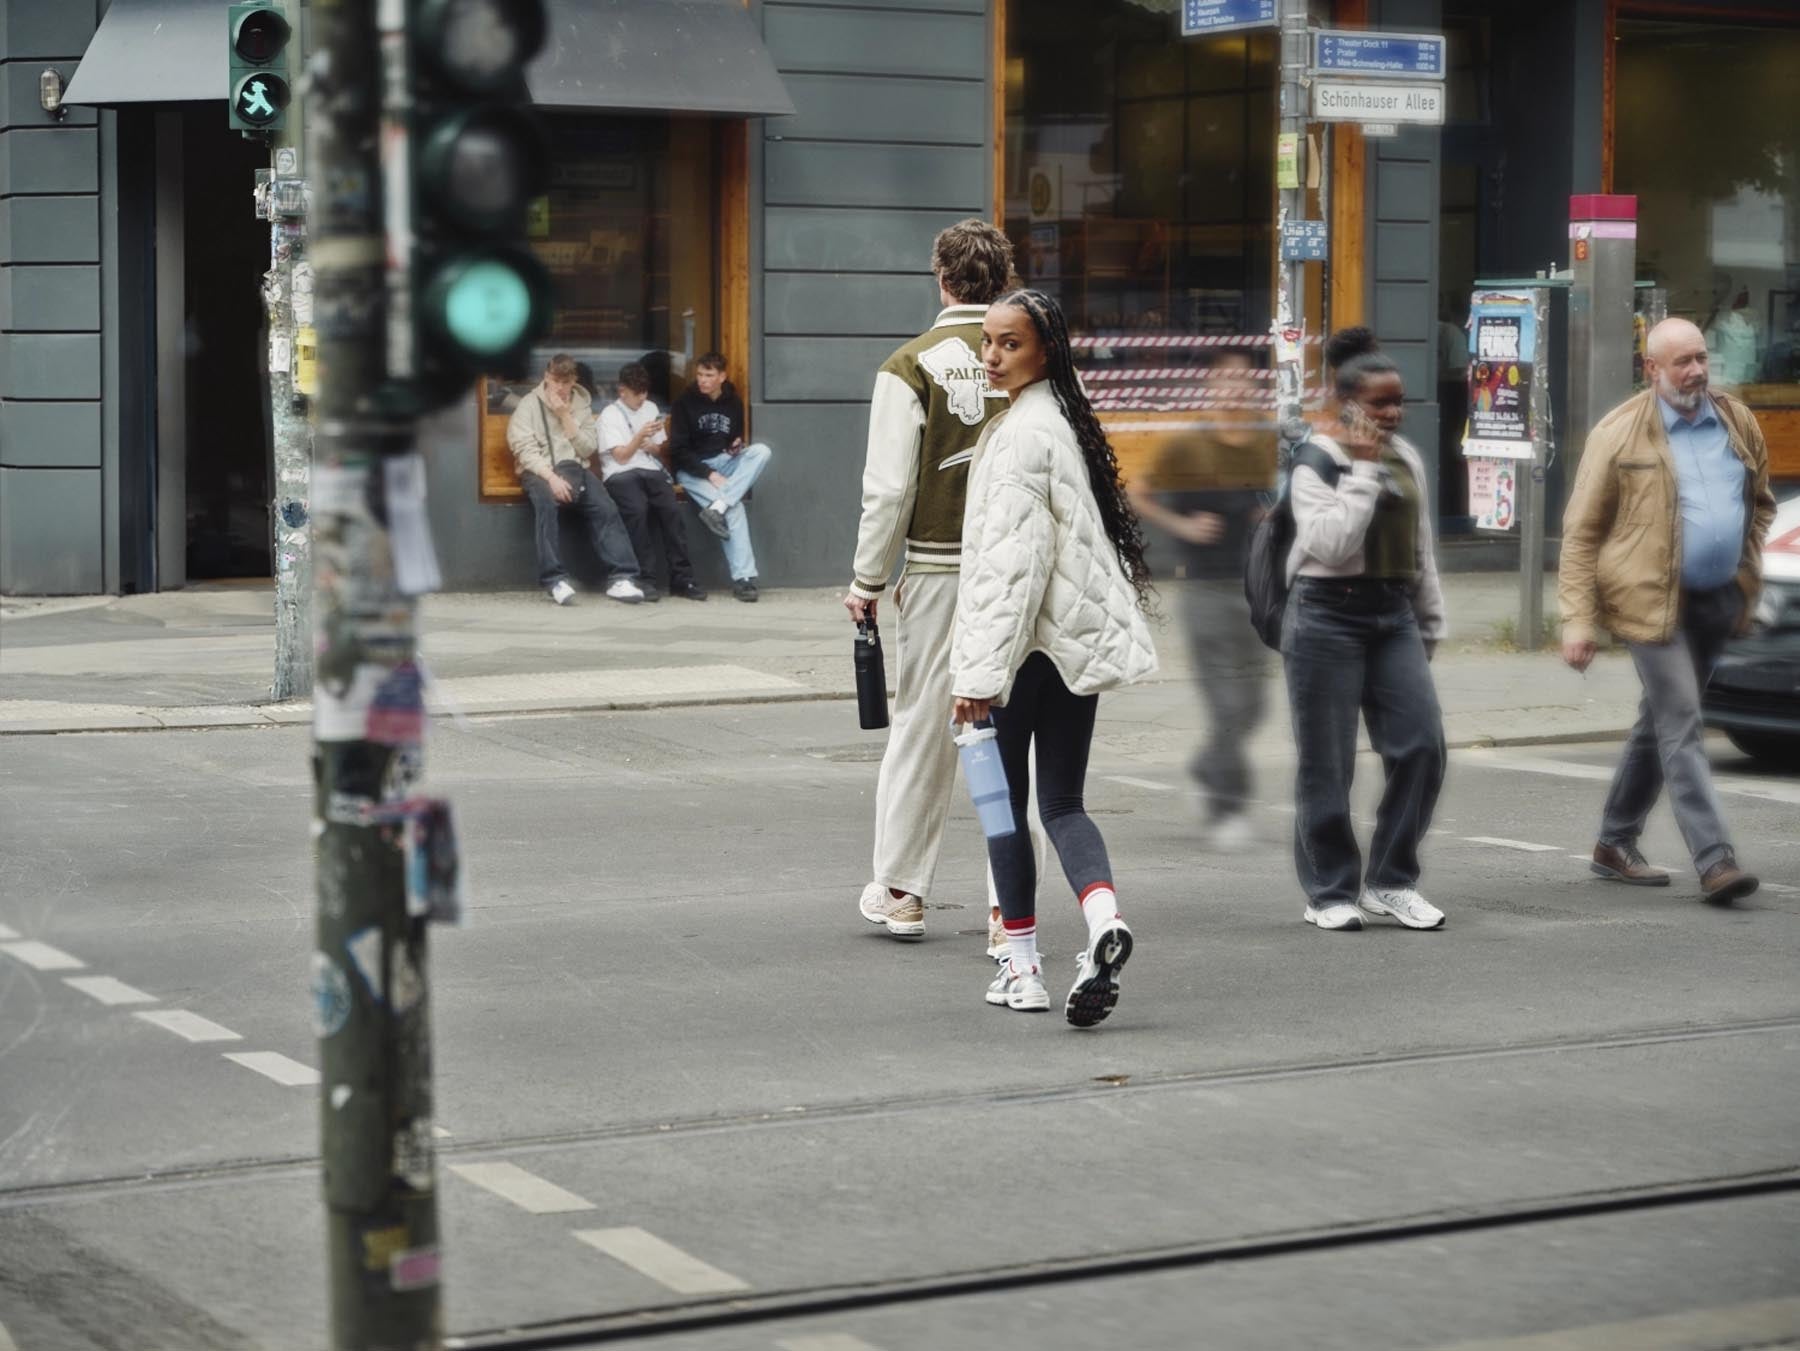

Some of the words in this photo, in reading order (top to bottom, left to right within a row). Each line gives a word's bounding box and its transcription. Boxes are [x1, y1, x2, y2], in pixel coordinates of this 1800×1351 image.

[1337, 38, 1361, 47] Theater
[1363, 40, 1379, 48] Dock
[1381, 41, 1388, 49] 11
[1321, 90, 1398, 109] Schönhauser
[1405, 92, 1436, 110] Allee
